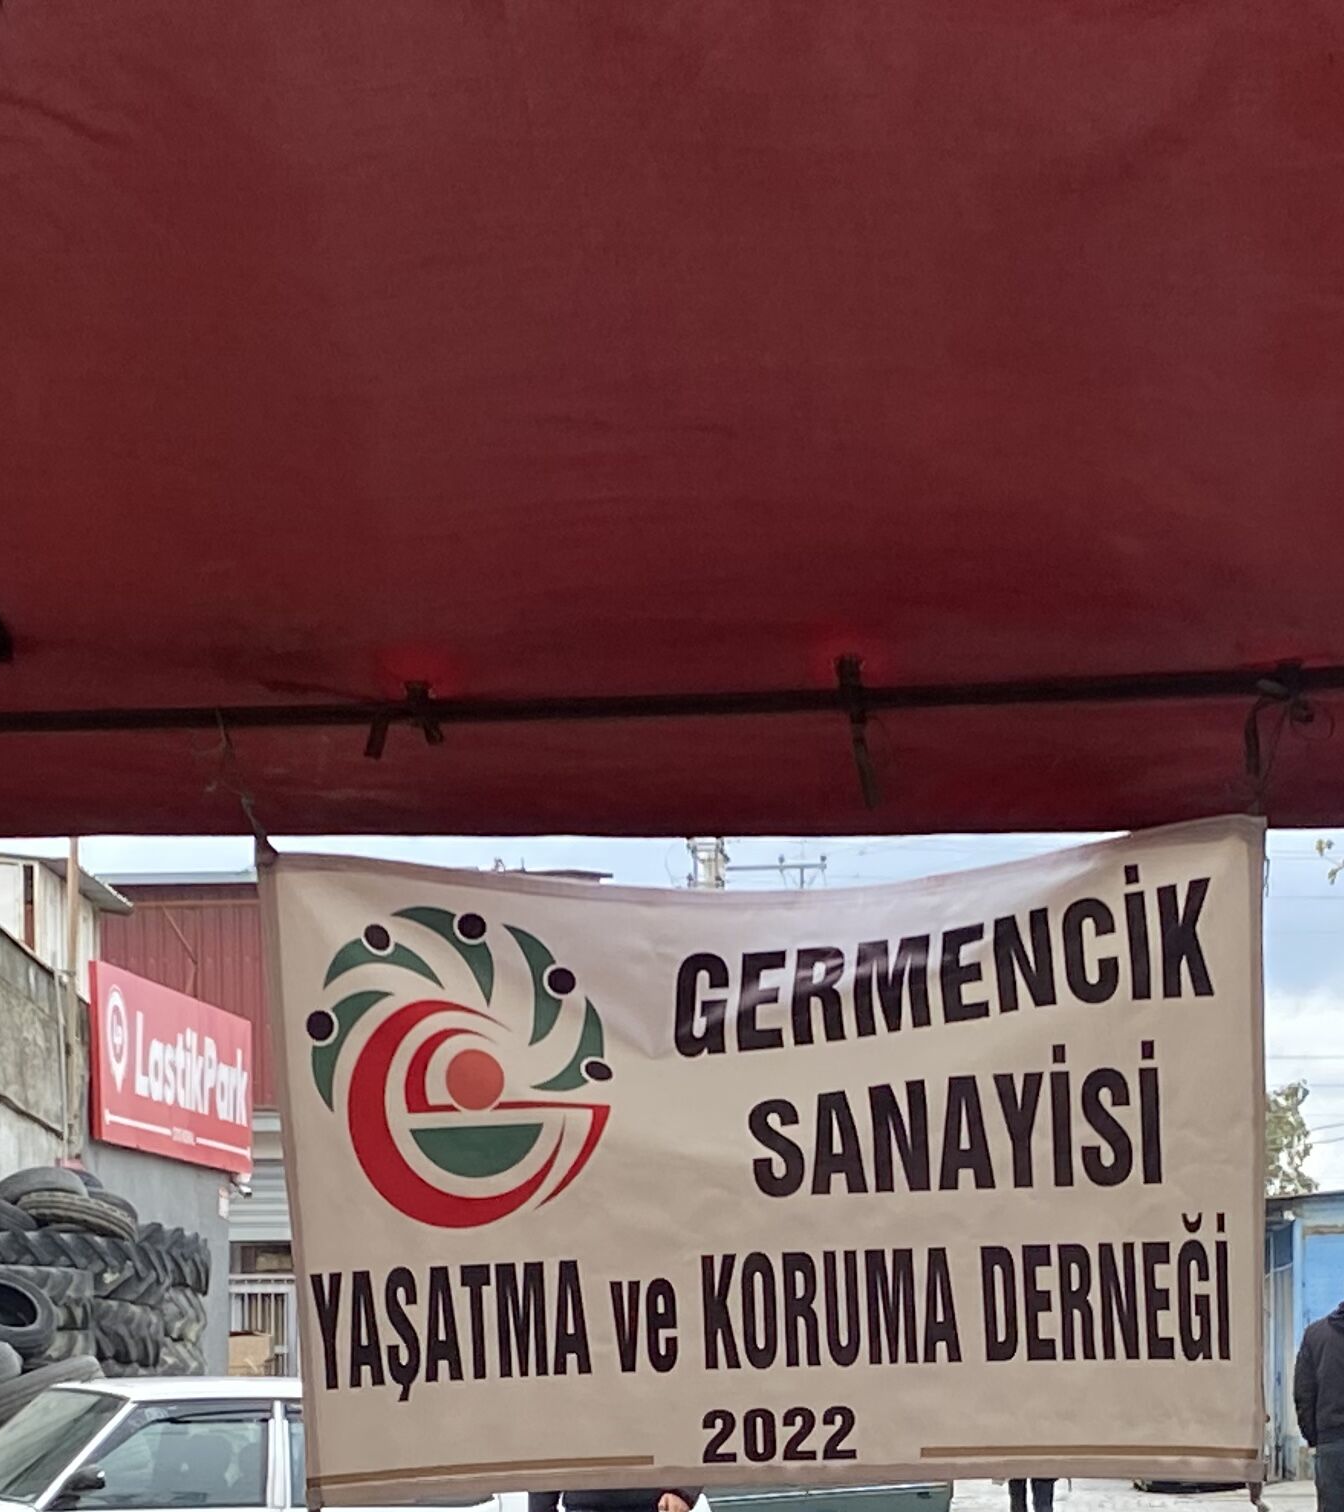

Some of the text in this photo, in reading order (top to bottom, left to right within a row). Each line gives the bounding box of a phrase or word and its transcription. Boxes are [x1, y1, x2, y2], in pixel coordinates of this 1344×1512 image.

[674, 864, 1214, 1057] GERMENCİK
[135, 1010, 248, 1128] LastikPark
[748, 1040, 1163, 1198] SANAYİSİ
[310, 1211, 1231, 1402] YAŞATMA ve KORUMA DERNEĞİ
[702, 1406, 857, 1464] 2022
